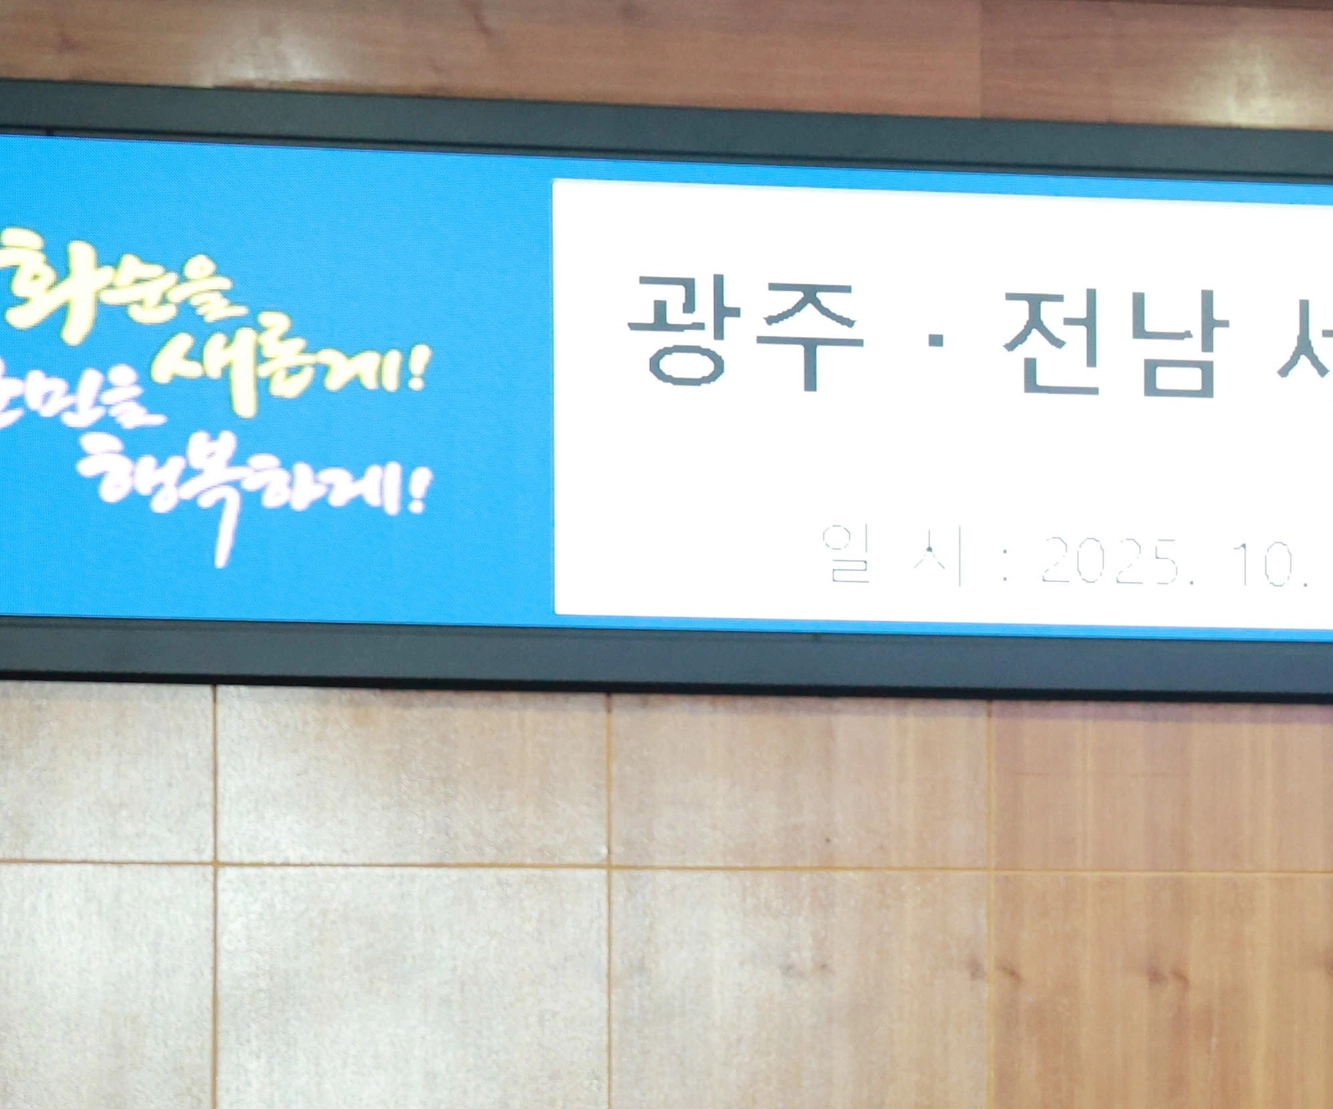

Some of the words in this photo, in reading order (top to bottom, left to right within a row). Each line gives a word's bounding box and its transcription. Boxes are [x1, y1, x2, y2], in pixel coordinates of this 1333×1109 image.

[0, 226, 249, 346] 화순을
[628, 274, 865, 392] 광주
[1002, 288, 1230, 398] 전남
[77, 430, 433, 569] 행복하게!
[1042, 536, 1195, 586] 2025.
[1232, 541, 1308, 589] 10.
